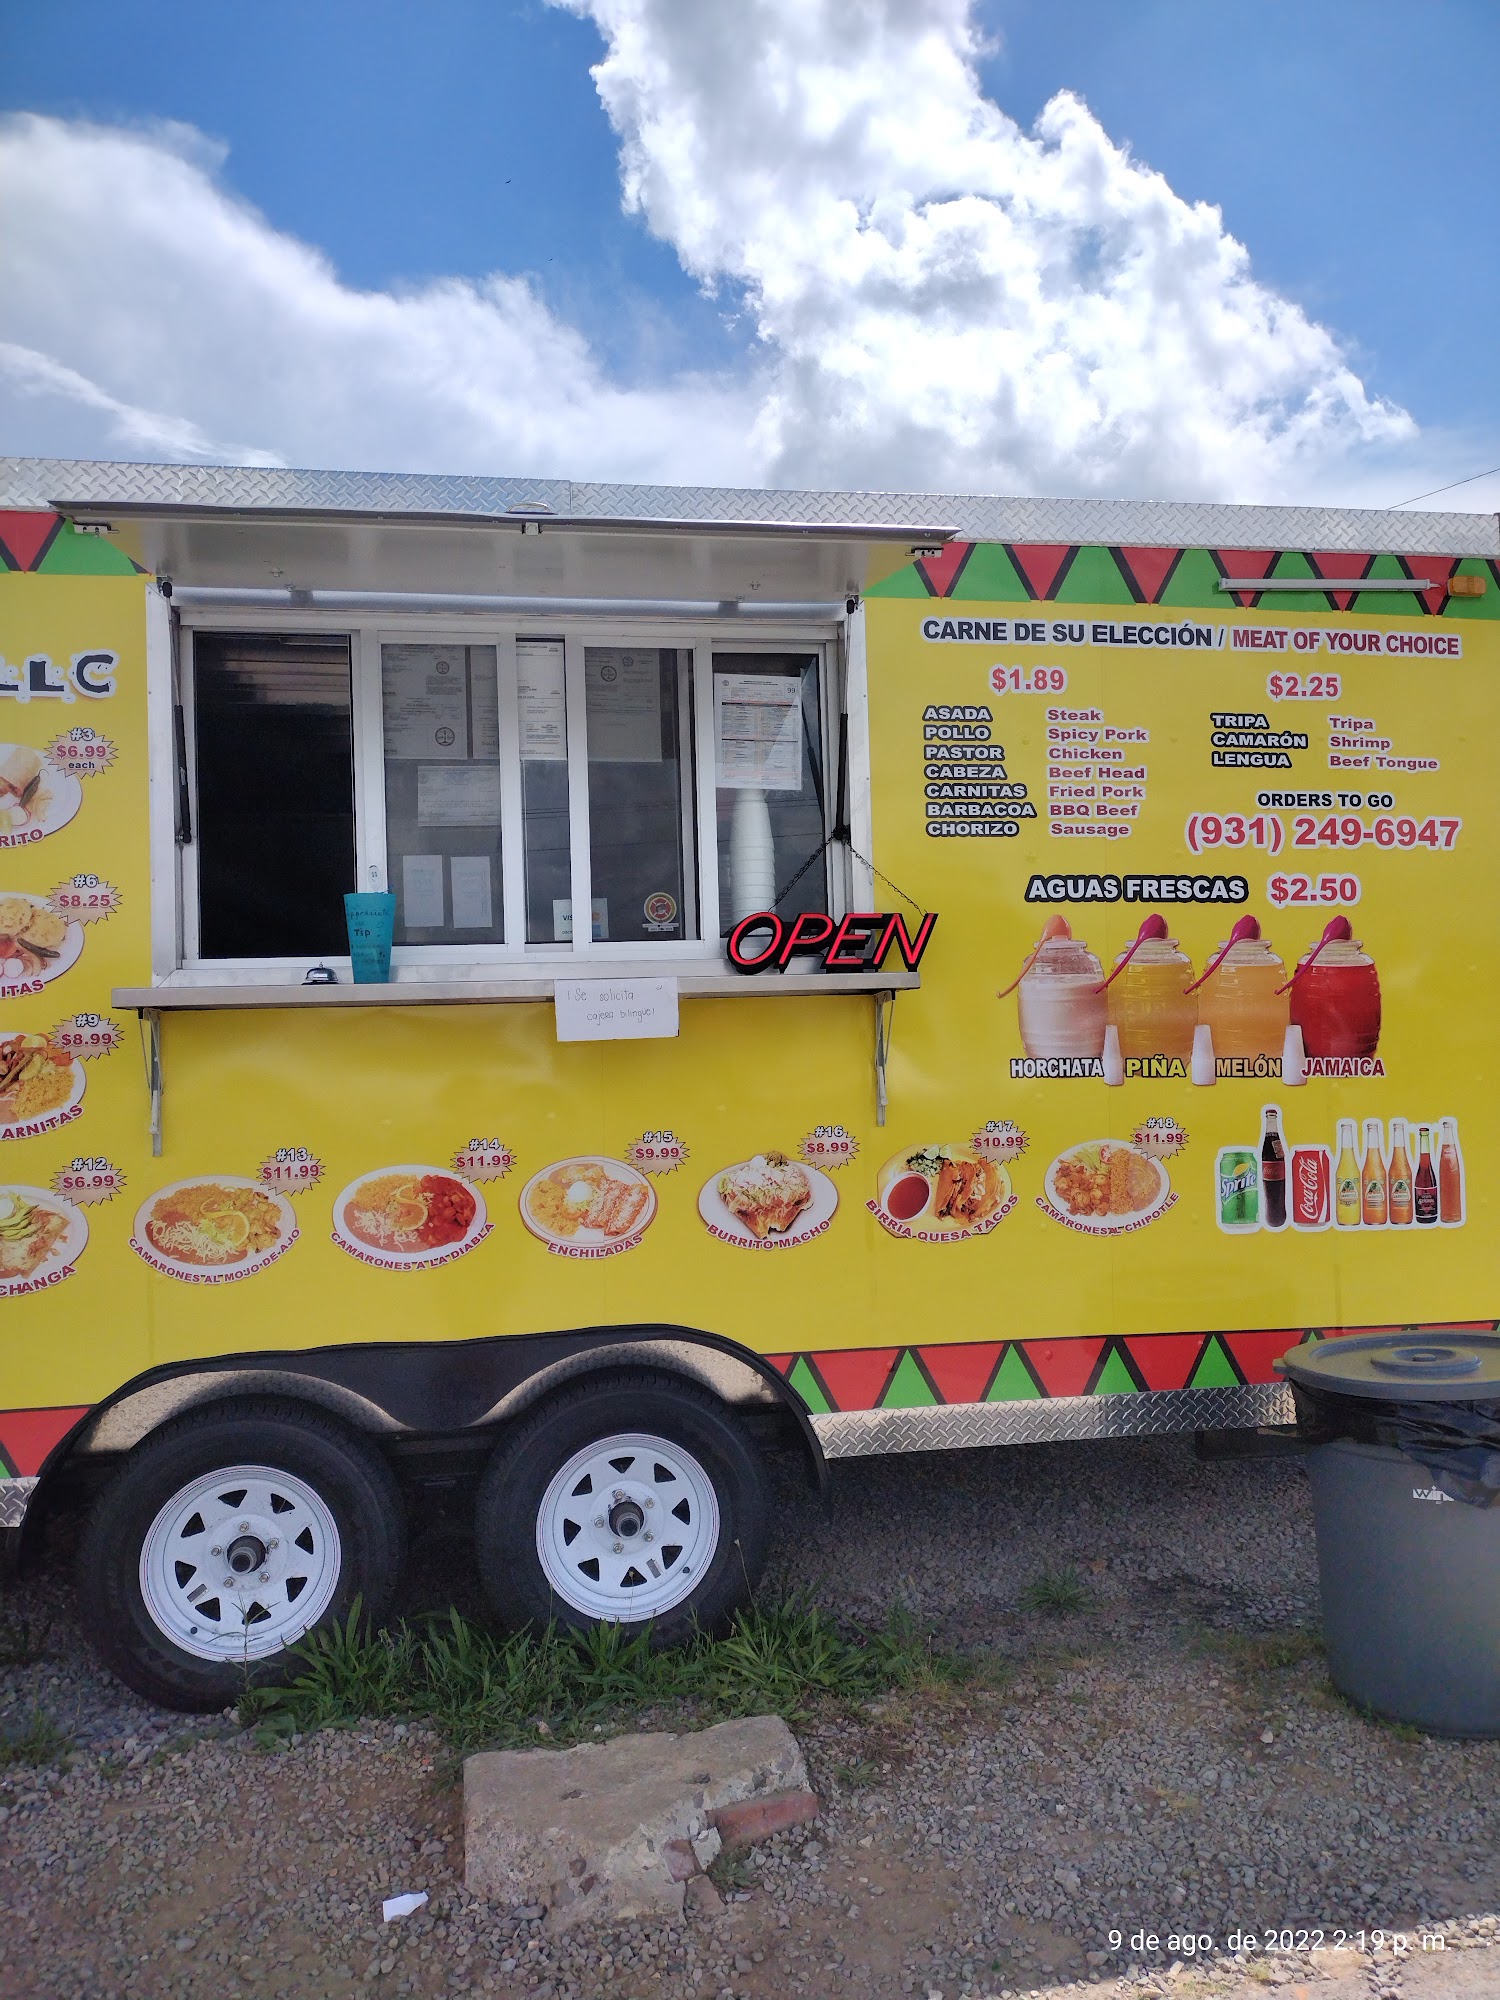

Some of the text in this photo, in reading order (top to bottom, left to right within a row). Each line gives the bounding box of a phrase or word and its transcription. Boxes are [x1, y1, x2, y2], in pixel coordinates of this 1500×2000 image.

[923, 620, 1459, 656] CARNE DE SU ELECCIÓN / MEAT OF YOUR CHOICE
[992, 667, 1065, 692] $1.89
[1269, 674, 1339, 698] $2.25
[923, 706, 992, 721] ASADA
[1047, 709, 1101, 721] Steak
[1211, 714, 1269, 728] TRIPA
[1329, 717, 1374, 732] Tripa
[69, 727, 95, 742] #3
[924, 726, 991, 740] POLLO
[1048, 728, 1147, 742] Spicy Pork
[1211, 732, 1307, 748] CAMARÓN
[1330, 736, 1391, 751] Shrimp
[56, 745, 107, 760] $6.99
[925, 746, 1004, 760] PASTOR
[1048, 747, 1122, 760] Chicken
[68, 761, 95, 769] each
[1213, 752, 1291, 768] LENGUA
[1329, 755, 1438, 771] Beef Tongue
[925, 765, 1007, 779] CABEZA
[1049, 767, 1145, 779] Beef Head
[926, 784, 1027, 798] CARNITAS
[1049, 786, 1143, 798] Fried Pork
[1257, 793, 1394, 808] ORDERS TO GO
[927, 803, 1036, 817] BARBACOA
[1050, 804, 1138, 817] BBQ Beef
[927, 822, 1018, 836] CHORIZO
[1051, 823, 1129, 837] Sausage
[1188, 816, 1460, 852] (931) 249-6947
[74, 874, 99, 888] #6
[1029, 876, 1357, 904] AGUAS FRESCAS $2.50
[59, 894, 111, 908] $8.25
[727, 911, 939, 975] OPEN
[1, 979, 44, 998] ITAS
[600, 988, 634, 1002] solicita
[75, 1014, 100, 1027] #9
[587, 1010, 614, 1026] cajera
[61, 1033, 112, 1047] $8.99
[1010, 1054, 1385, 1077] HORCHATA PIÑA MELÓN JAMAICA
[1, 1104, 83, 1139] ARNITAS
[985, 1120, 1014, 1132] #17
[1146, 1117, 1175, 1129] #18
[642, 1131, 674, 1143] #15
[814, 1125, 844, 1138] #16
[1134, 1133, 1184, 1144] $11.99
[468, 1138, 501, 1151] #14
[806, 1142, 850, 1154] $8.99
[973, 1136, 1024, 1149] $10.99
[275, 1147, 308, 1162] #13
[635, 1147, 680, 1160] $9.99
[71, 1157, 108, 1171] #12
[456, 1154, 511, 1169] $11.99
[262, 1164, 320, 1181] $11.99
[62, 1175, 115, 1190] $6.99
[1221, 1171, 1256, 1199] Sprite
[865, 1194, 1019, 1242] BIRRIA QUESA TACOS
[1035, 1196, 1107, 1235] CAMARONES
[1124, 1192, 1179, 1232] CHIPOTLE
[707, 1219, 831, 1249] BURRITO MACHO
[330, 1223, 495, 1270] CAMARONES A LA DIABLA
[548, 1234, 643, 1258] ENCHILADAS
[128, 1229, 301, 1283] CAMARONES AL MOJO DE AJO
